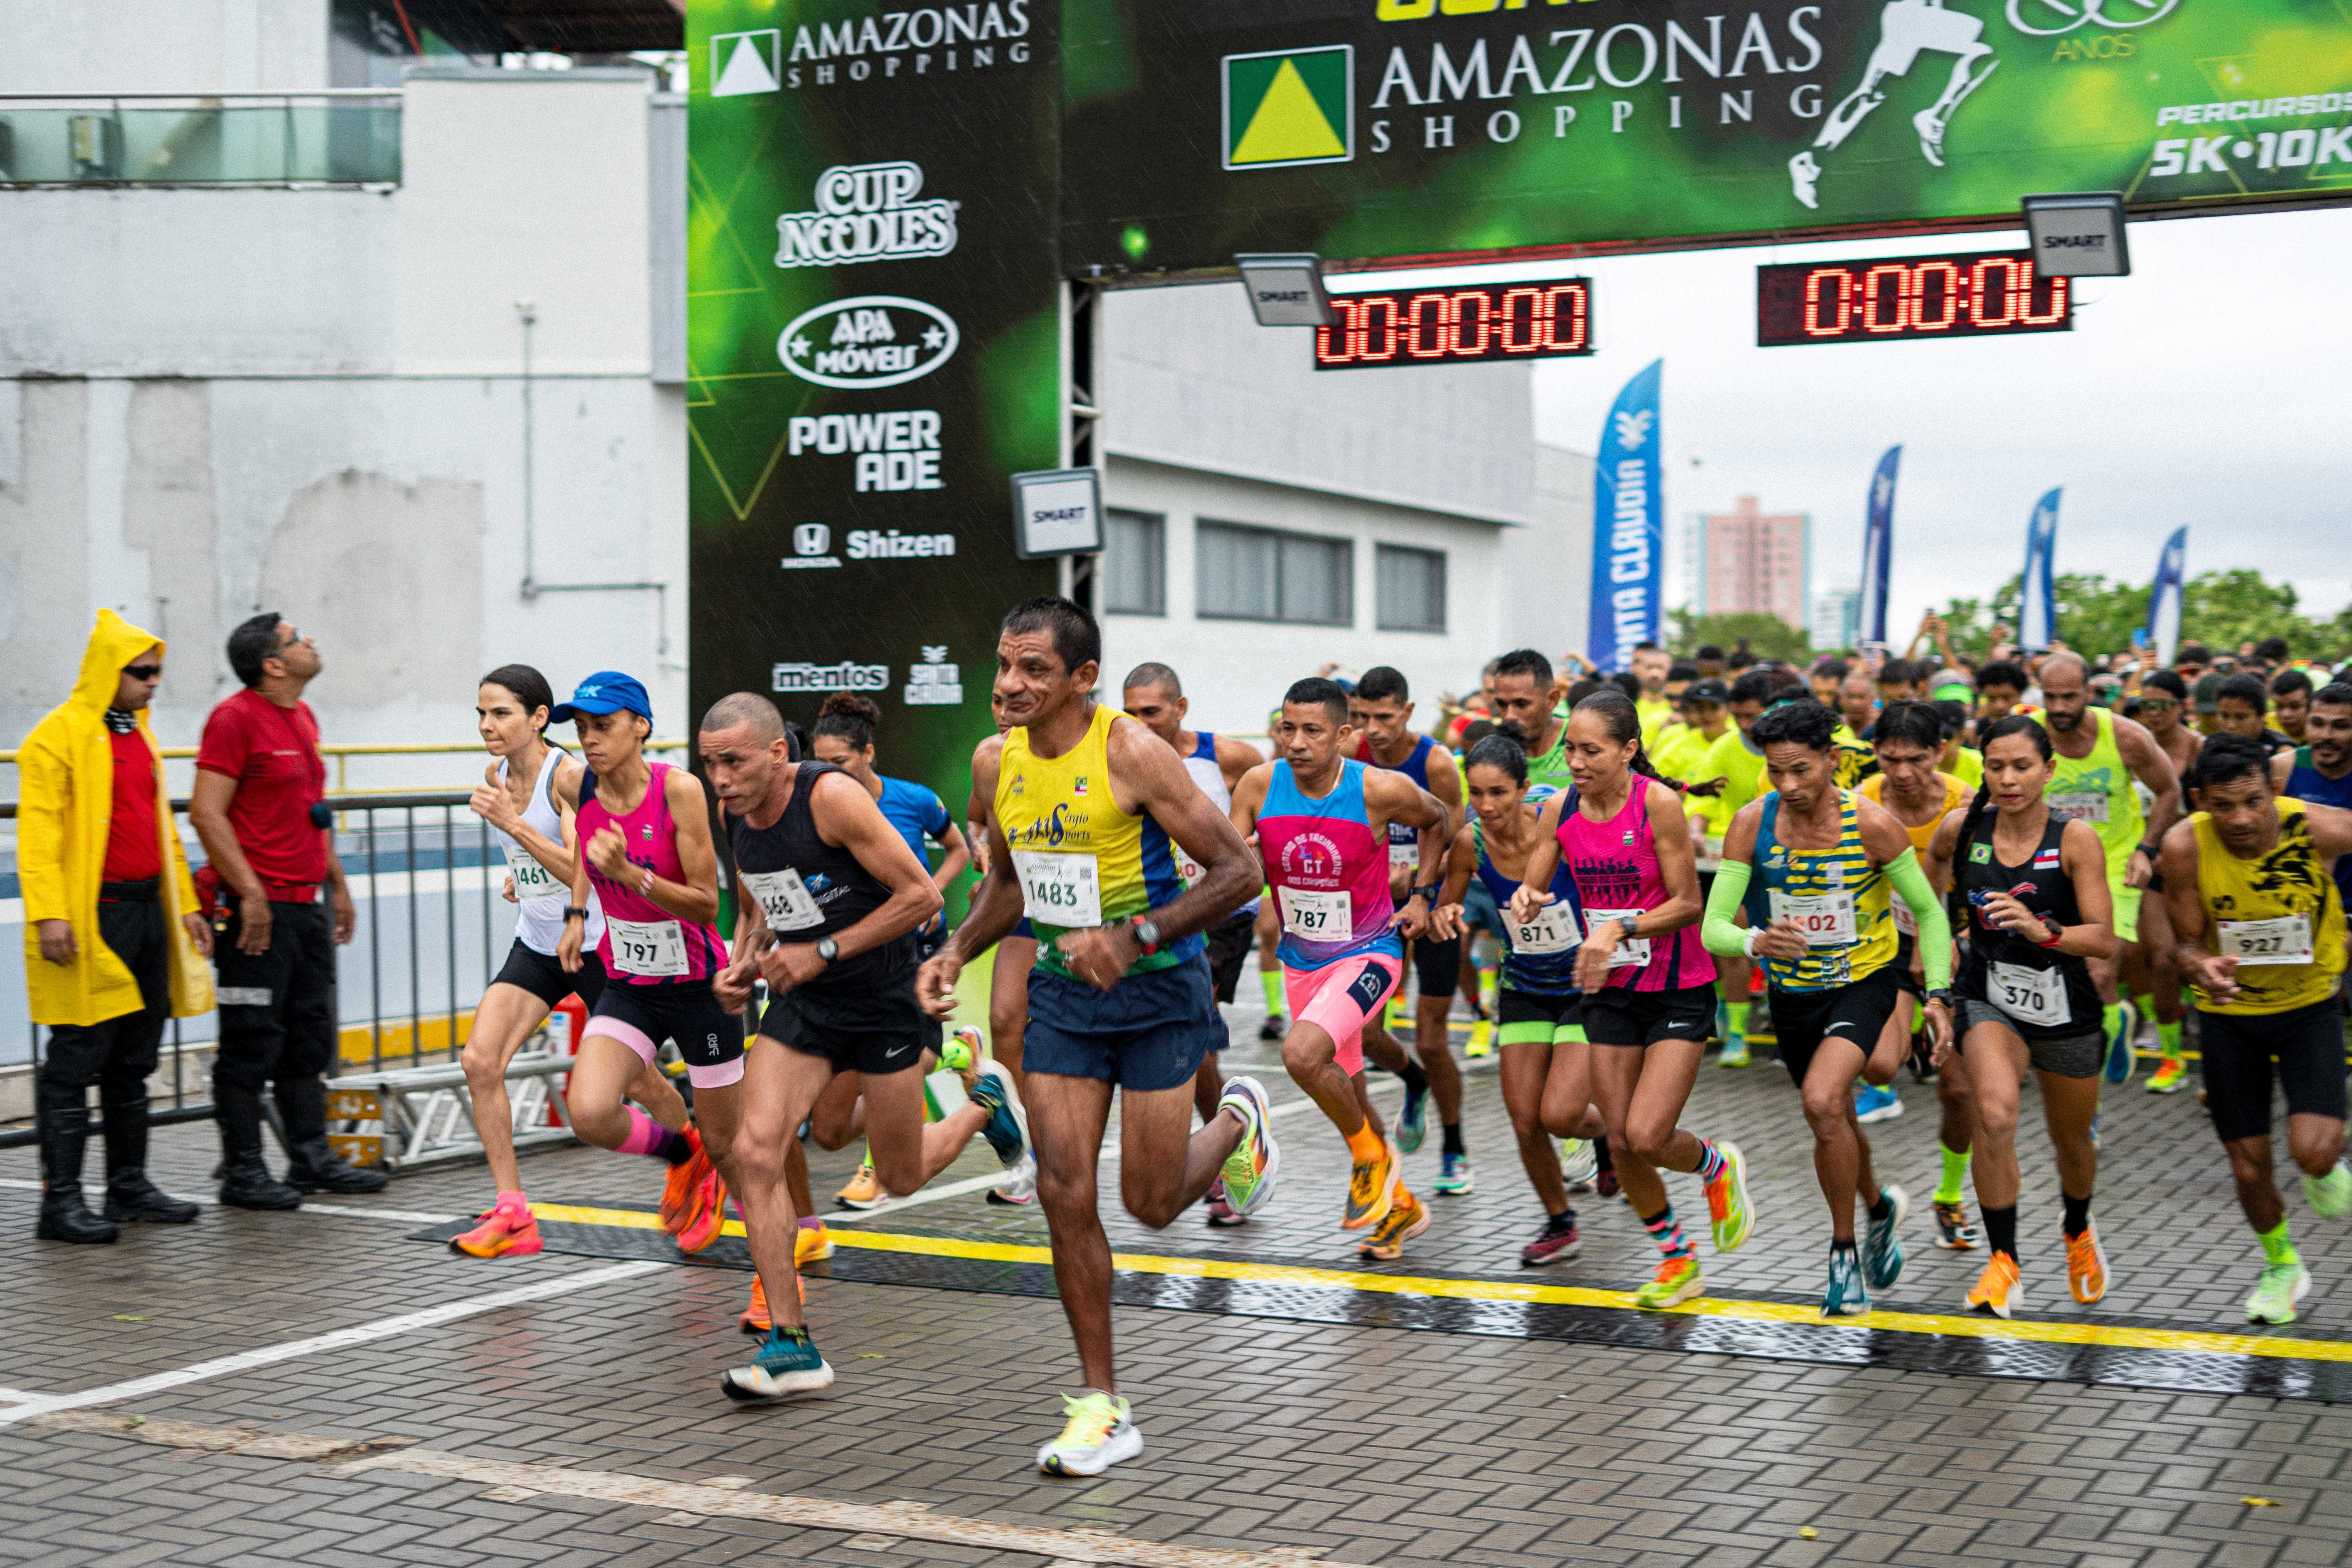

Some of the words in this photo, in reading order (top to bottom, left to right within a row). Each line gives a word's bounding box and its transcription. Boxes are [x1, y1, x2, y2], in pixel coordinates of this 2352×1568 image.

[788, 0, 1030, 62] AMAZONAS
[1371, 5, 1823, 109] AMAZONAS
[2052, 33, 2136, 64] ANOS
[788, 42, 1030, 89] SHOPPING
[1371, 84, 1823, 153] SHOPPING
[823, 167, 917, 215] CUP
[781, 206, 951, 261] NOODLES
[2043, 234, 2109, 250] SMART
[1258, 290, 1308, 302] SMART
[830, 309, 897, 345] APA
[1317, 285, 1587, 363] 00:00:00
[788, 410, 941, 456] POWER
[855, 451, 942, 492] ADE
[1611, 458, 1650, 584] CLAUDIA
[846, 528, 956, 559] Shizen
[1612, 586, 1648, 673] ANTA
[776, 666, 885, 689] mentos
[514, 867, 549, 885] 1461
[1303, 860, 1323, 874] CT
[1028, 880, 1077, 906] 1483
[1294, 909, 1327, 928] 787
[1520, 926, 1555, 942] 871
[623, 940, 658, 962] 797
[2239, 936, 2284, 953] 927
[2004, 985, 2045, 1011] 370
